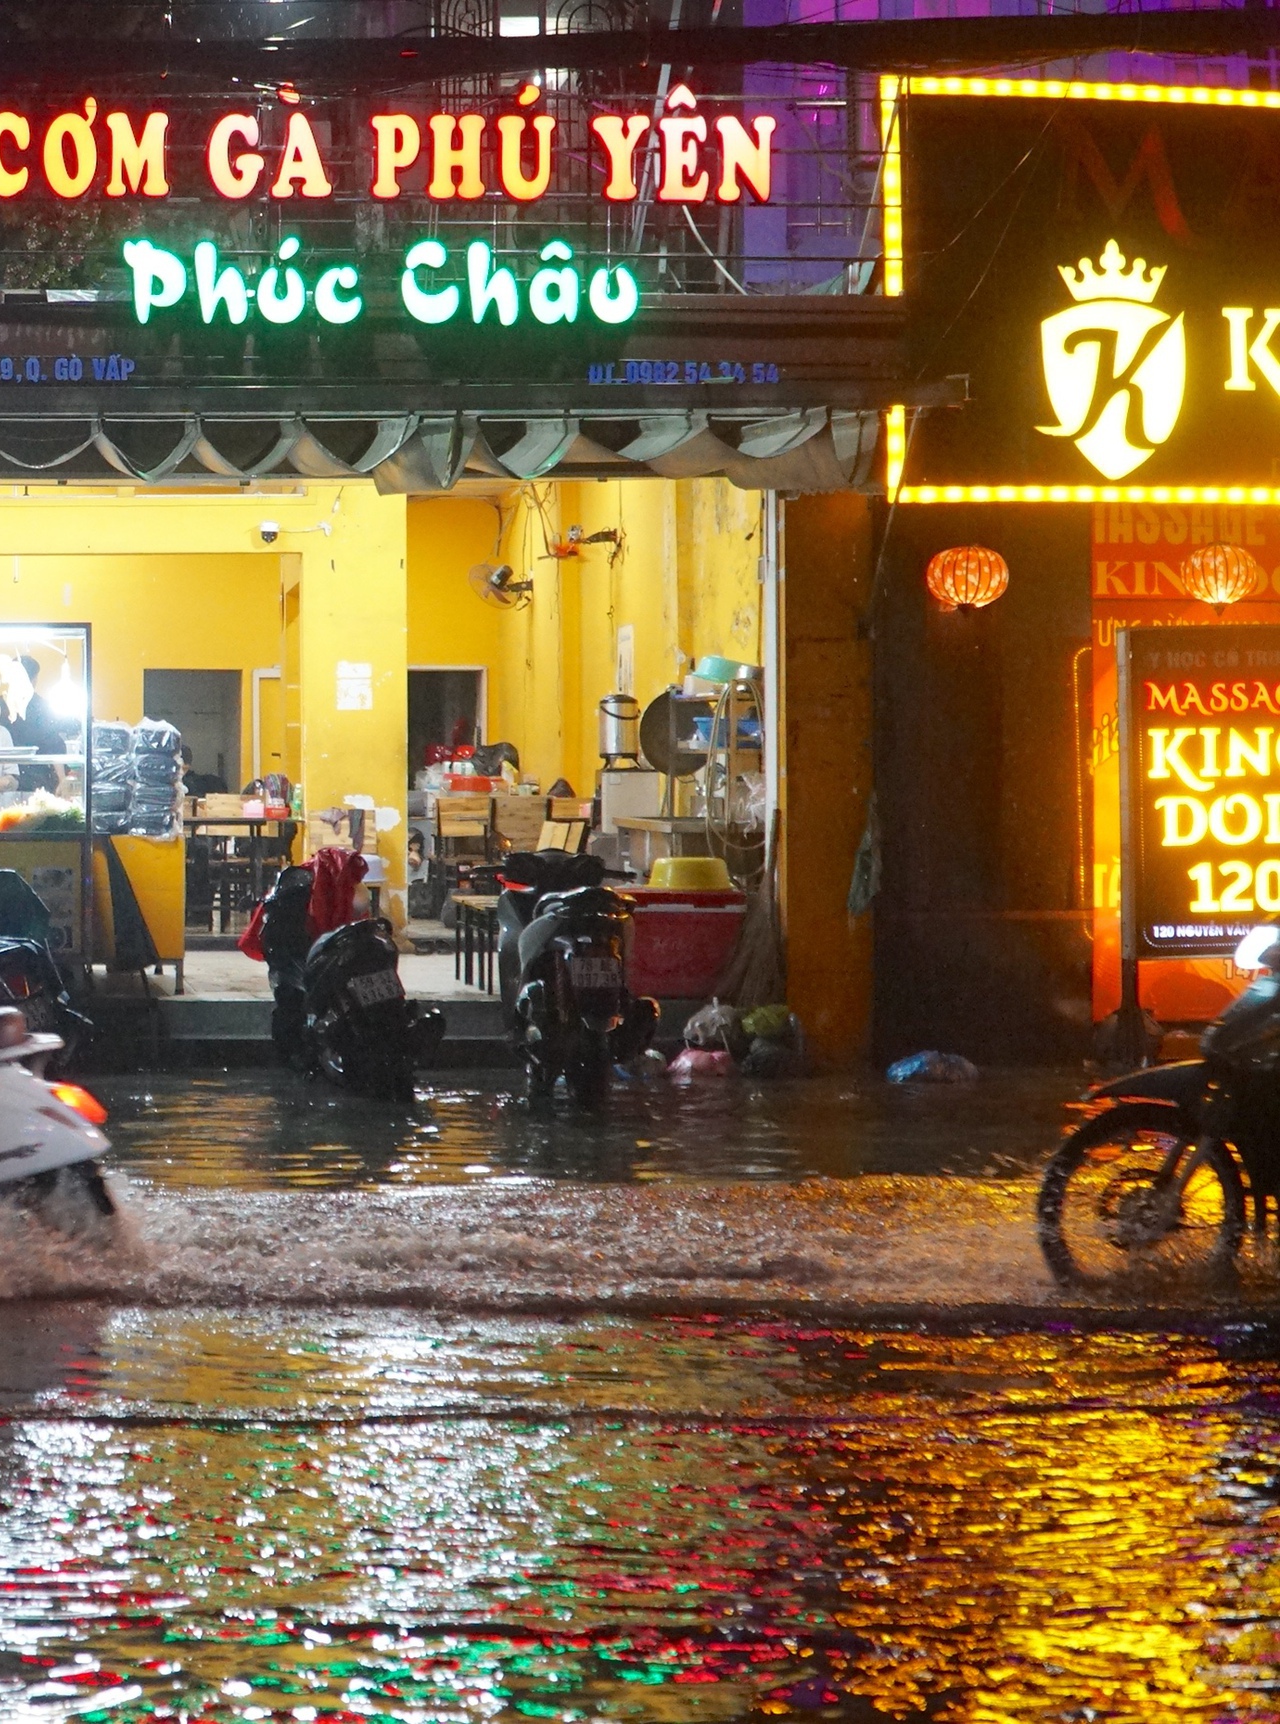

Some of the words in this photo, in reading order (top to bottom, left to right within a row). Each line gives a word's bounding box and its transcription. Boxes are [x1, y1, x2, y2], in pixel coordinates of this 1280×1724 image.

[208, 82, 332, 198] GÀ
[371, 84, 556, 200] PHÚ
[592, 84, 777, 202] YÊN
[123, 237, 362, 324] Phúc
[402, 240, 639, 326] Châu
[752, 362, 779, 384] 54
[1145, 681, 1280, 716] MASSA
[1147, 726, 1280, 792] KIN
[1153, 925, 1175, 938] 120
